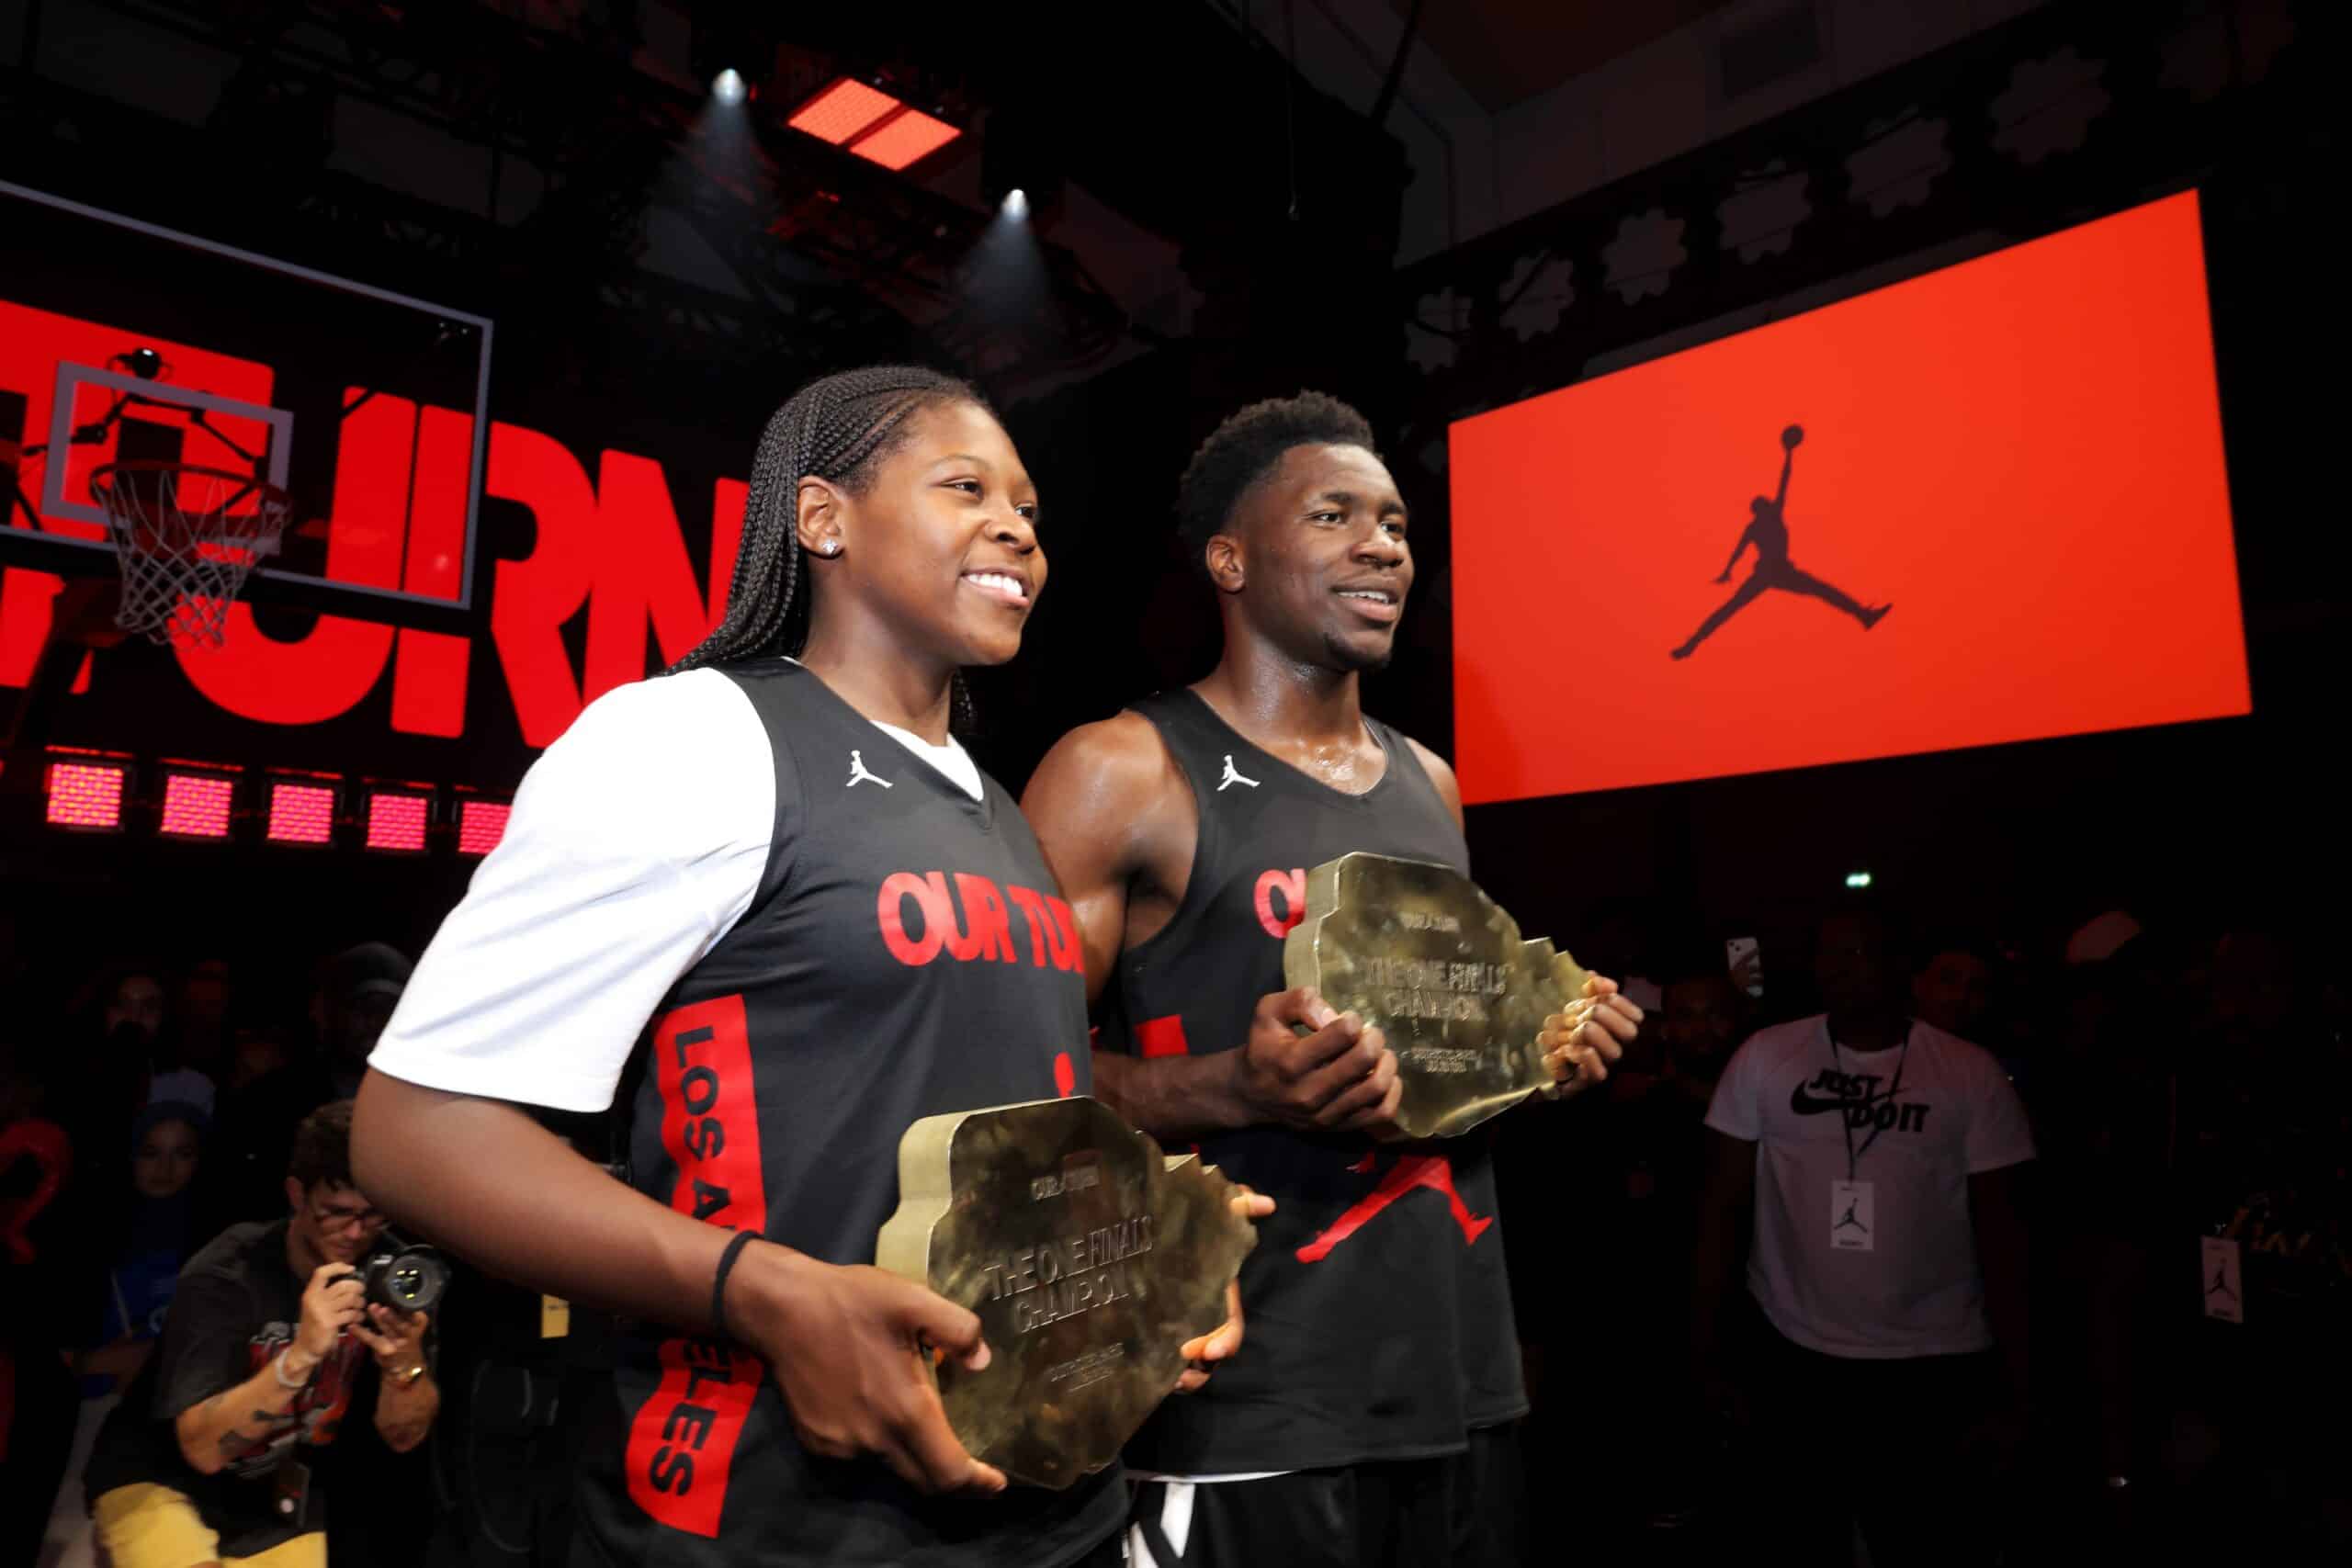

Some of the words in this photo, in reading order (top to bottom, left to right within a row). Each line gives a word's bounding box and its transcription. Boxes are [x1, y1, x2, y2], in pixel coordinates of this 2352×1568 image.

[876, 871, 1017, 966] OUR
[1007, 885, 1086, 974] TU
[675, 1025, 725, 1162] LOS
[1809, 1068, 1883, 1102] JUST
[1898, 1104, 1929, 1132] IT
[1036, 1237, 1095, 1284] OE
